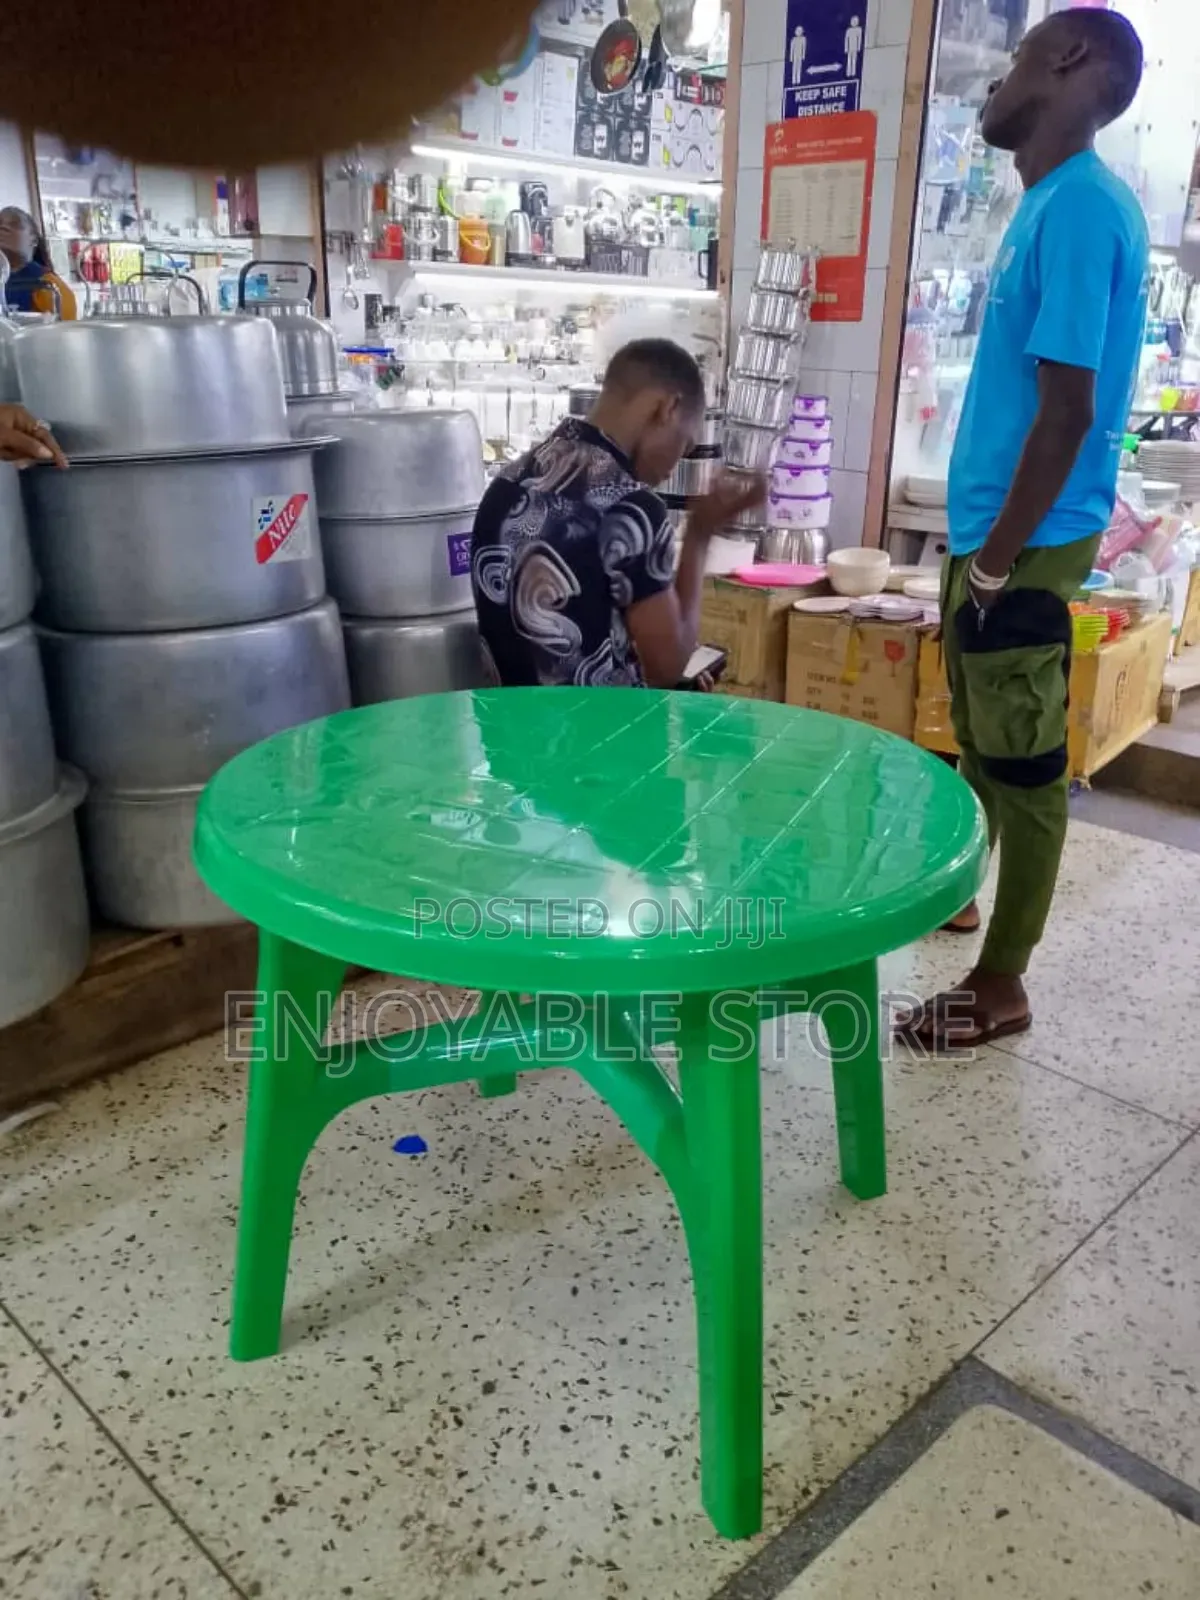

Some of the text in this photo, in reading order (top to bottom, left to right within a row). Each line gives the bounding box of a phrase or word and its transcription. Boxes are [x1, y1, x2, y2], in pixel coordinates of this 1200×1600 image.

[795, 85, 848, 102] KEEP SAFE
[798, 101, 847, 117] DISTANCE
